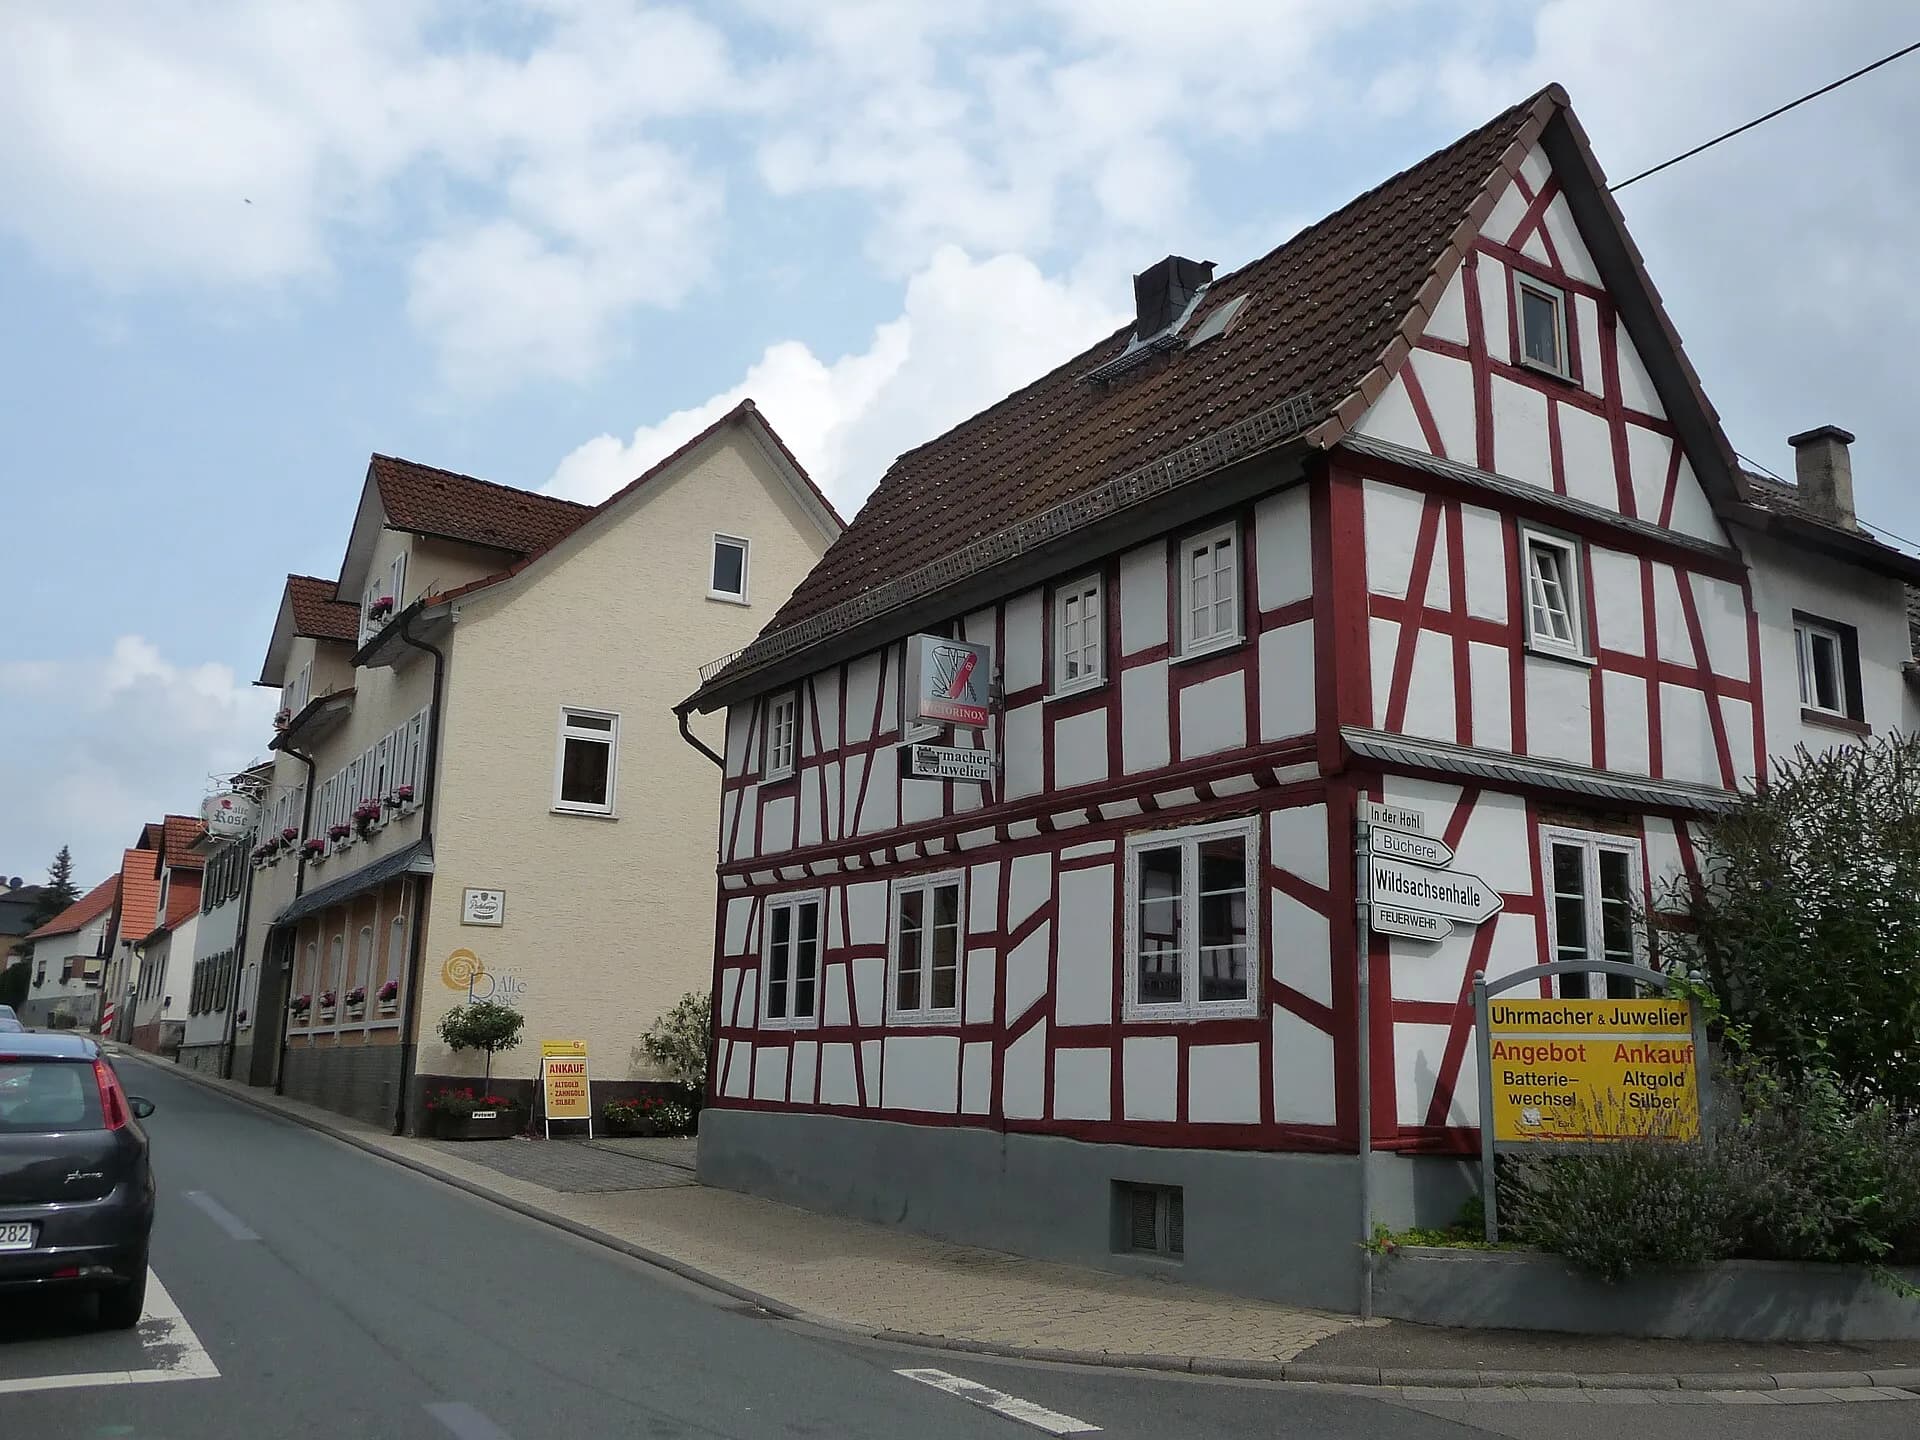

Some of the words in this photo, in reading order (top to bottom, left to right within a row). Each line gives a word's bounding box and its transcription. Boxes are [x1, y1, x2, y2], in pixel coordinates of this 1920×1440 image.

[1371, 805, 1380, 821] In
[1382, 808, 1396, 824] der
[1384, 834, 1437, 859] Bücherei
[1375, 868, 1480, 907] Wildsachsenhalle
[1380, 910, 1437, 930] FEUERWEHR
[1491, 1006, 1593, 1025] Uhrmacher
[1597, 1014, 1606, 1025] &
[1609, 1007, 1689, 1026] Juwelier
[1492, 1041, 1587, 1065] Angebot
[1613, 1043, 1695, 1064] Ankauf
[549, 1064, 585, 1074] ANKAUF
[1623, 1070, 1685, 1090] Altgold
[1508, 1091, 1577, 1106] wechsel
[1629, 1092, 1680, 1109] Silber
